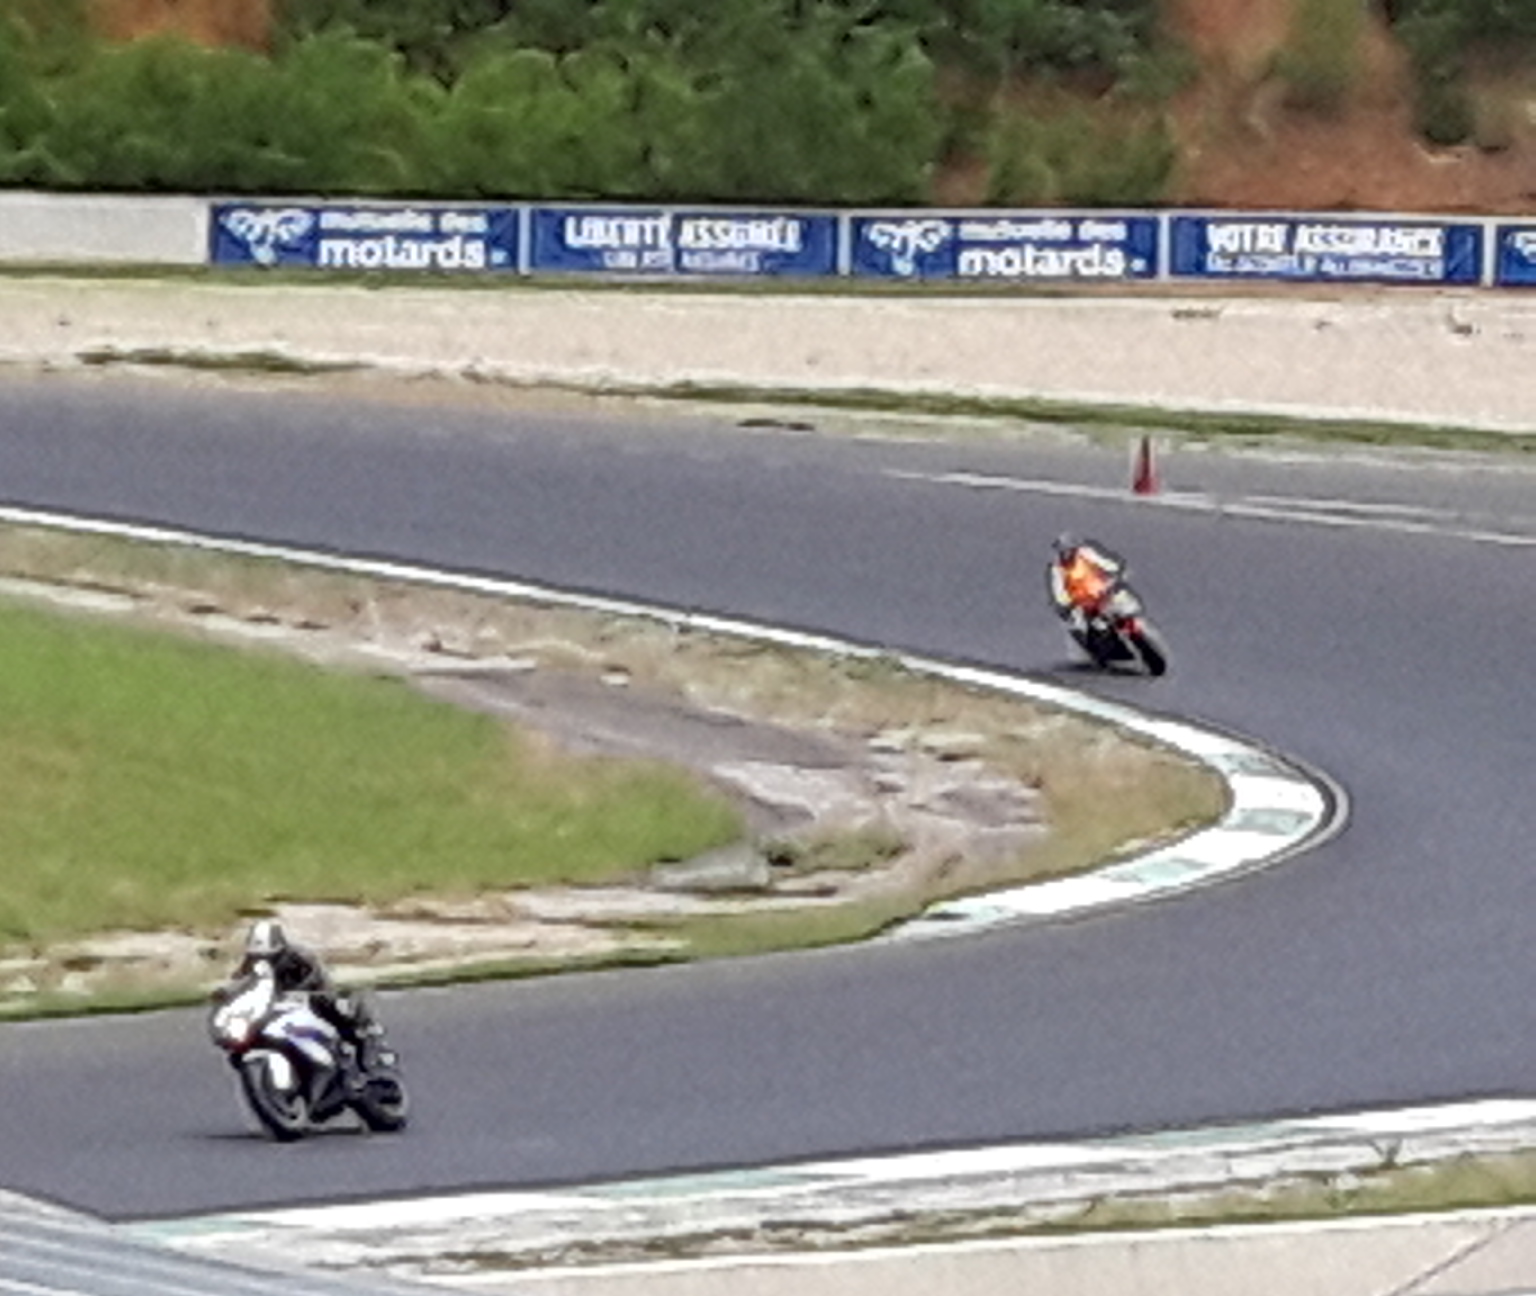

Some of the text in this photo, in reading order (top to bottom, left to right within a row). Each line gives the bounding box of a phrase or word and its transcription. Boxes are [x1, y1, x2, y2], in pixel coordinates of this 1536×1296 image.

[318, 235, 486, 268] motards
[1205, 223, 1289, 252] VOTRE
[958, 243, 1126, 276] motards
